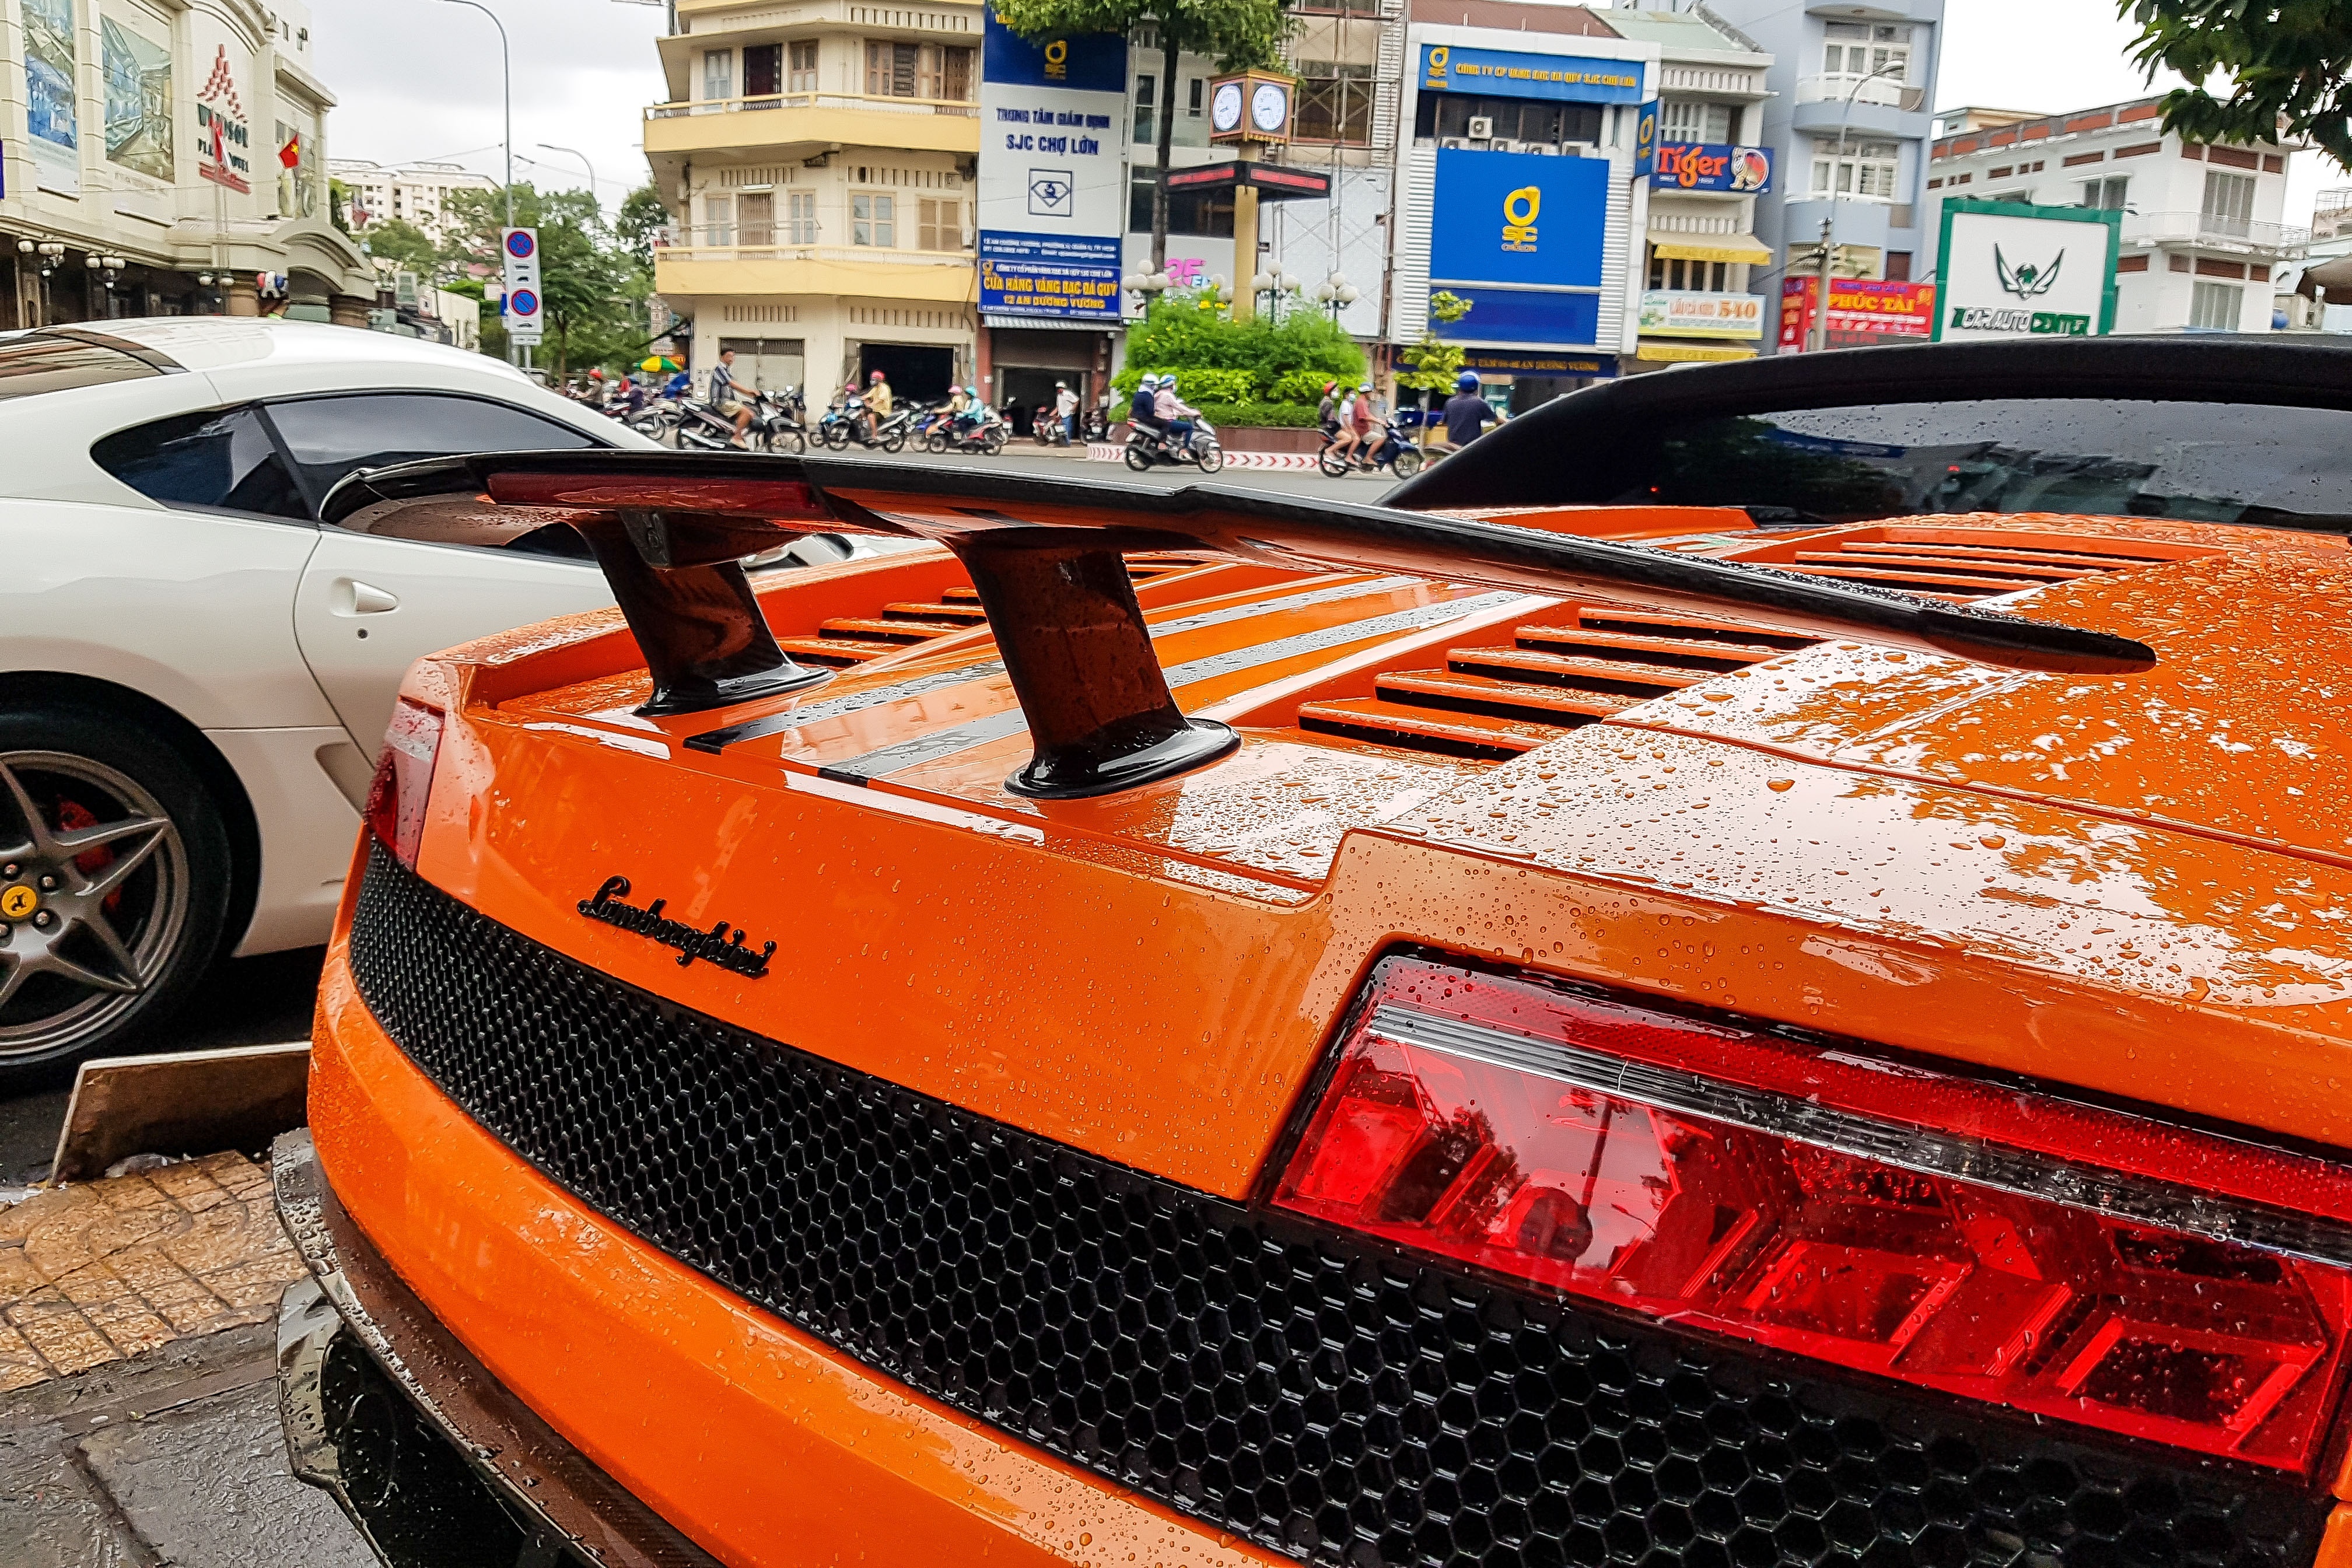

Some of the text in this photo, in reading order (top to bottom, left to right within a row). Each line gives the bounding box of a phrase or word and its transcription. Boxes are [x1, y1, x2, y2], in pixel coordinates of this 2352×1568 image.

[1006, 134, 1033, 150] SJC
[1658, 145, 1728, 187] Tiger
[1882, 295, 1916, 312] TÀI
[576, 875, 778, 979] Lamborghini
